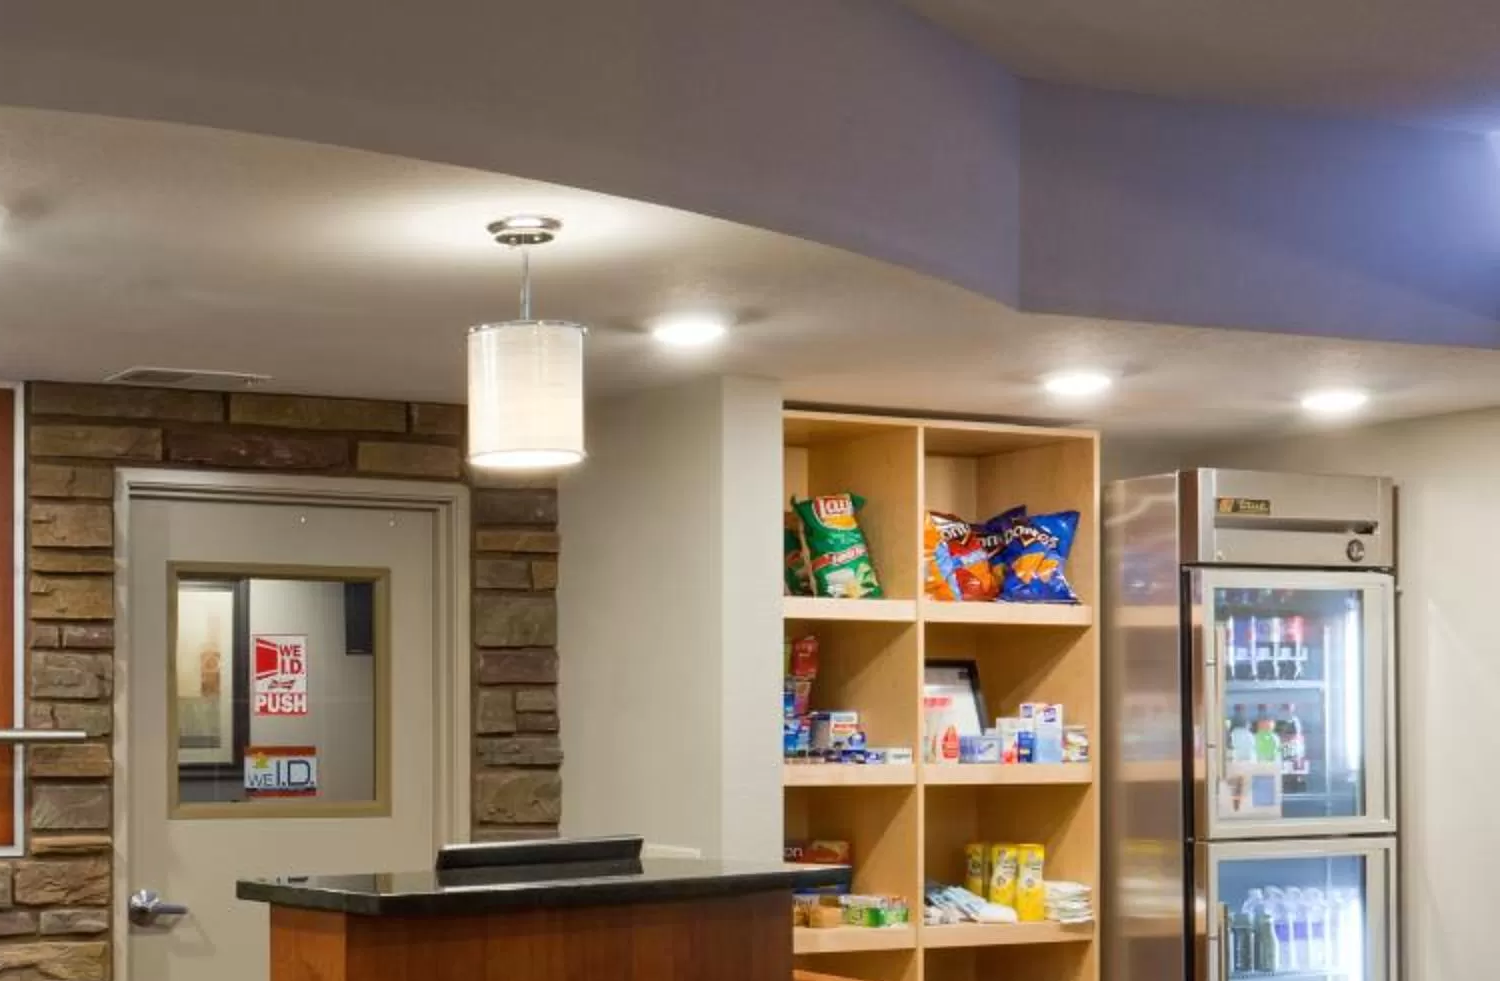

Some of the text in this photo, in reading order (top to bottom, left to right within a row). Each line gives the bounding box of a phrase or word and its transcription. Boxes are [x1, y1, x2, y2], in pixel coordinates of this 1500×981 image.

[279, 645, 301, 657] WE
[281, 659, 304, 675] I.D.
[254, 693, 307, 713] PUSH
[250, 759, 315, 786] WE I.D.
